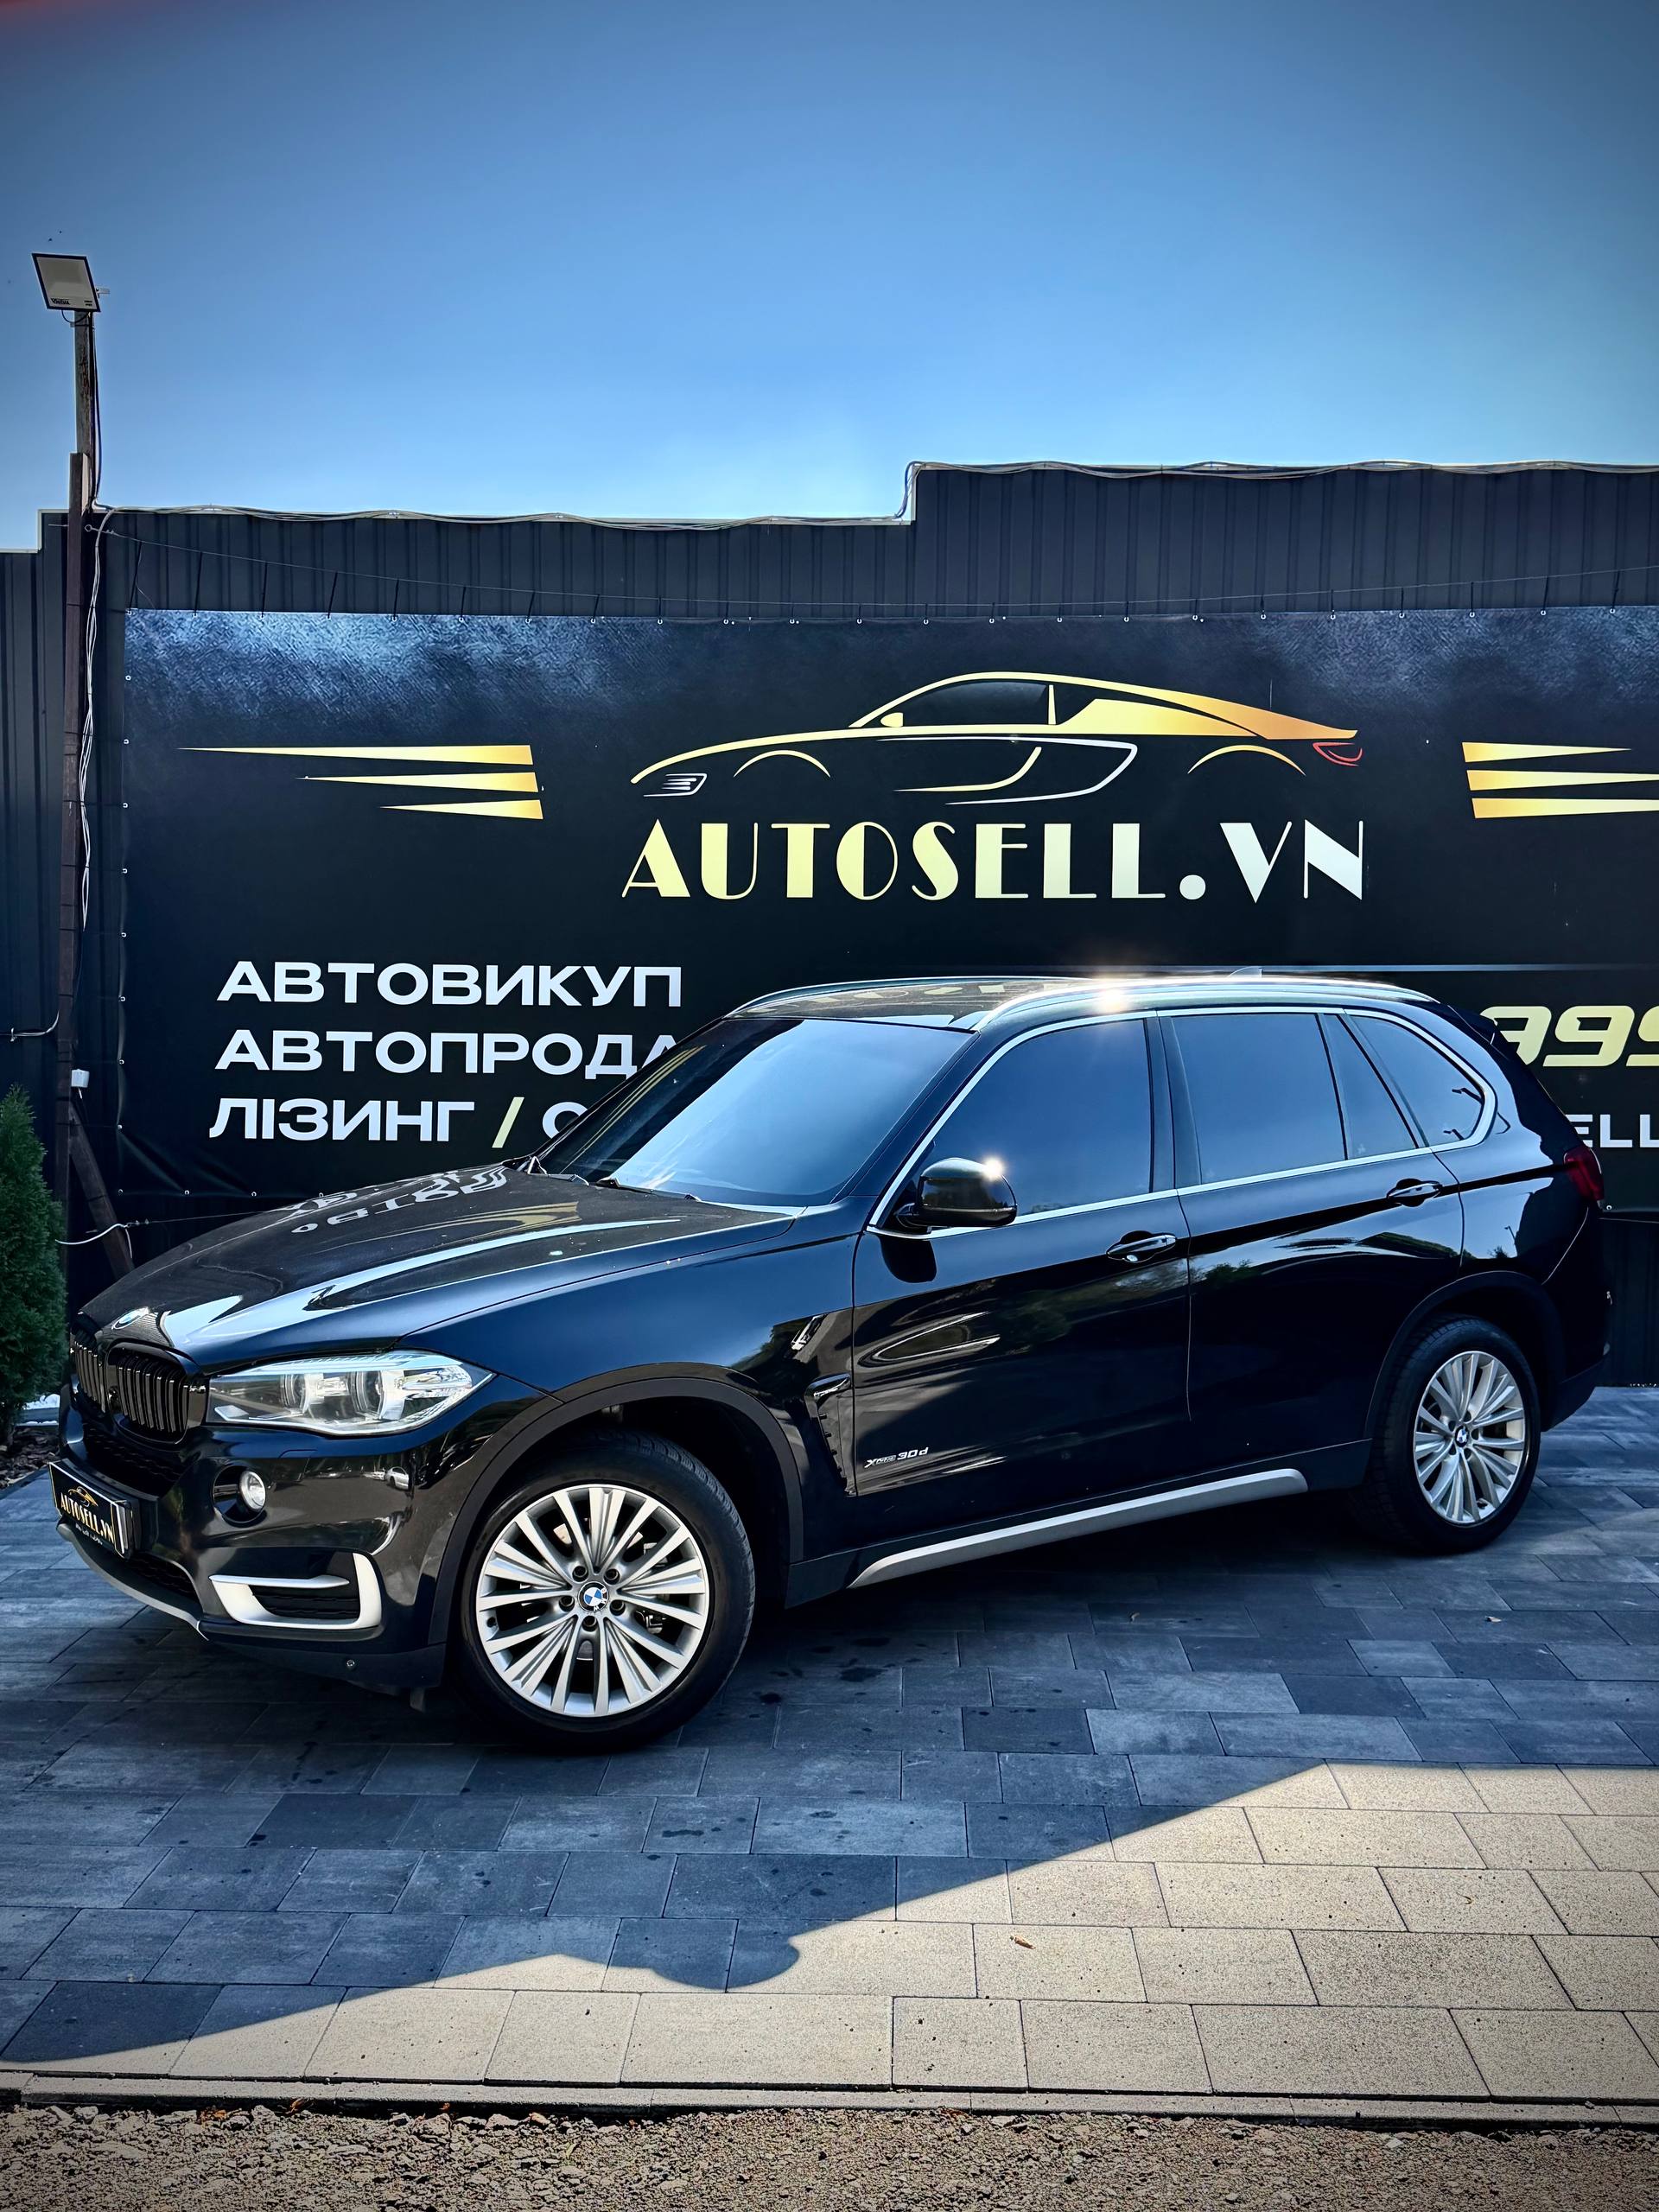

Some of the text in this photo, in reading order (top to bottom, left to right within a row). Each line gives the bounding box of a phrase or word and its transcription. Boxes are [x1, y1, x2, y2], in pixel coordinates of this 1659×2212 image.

[621, 819, 1364, 904] AUTOSELL.VN
[216, 961, 683, 1007] АВТОВИКУП
[209, 1097, 475, 1142] ЛІЗИНГ
